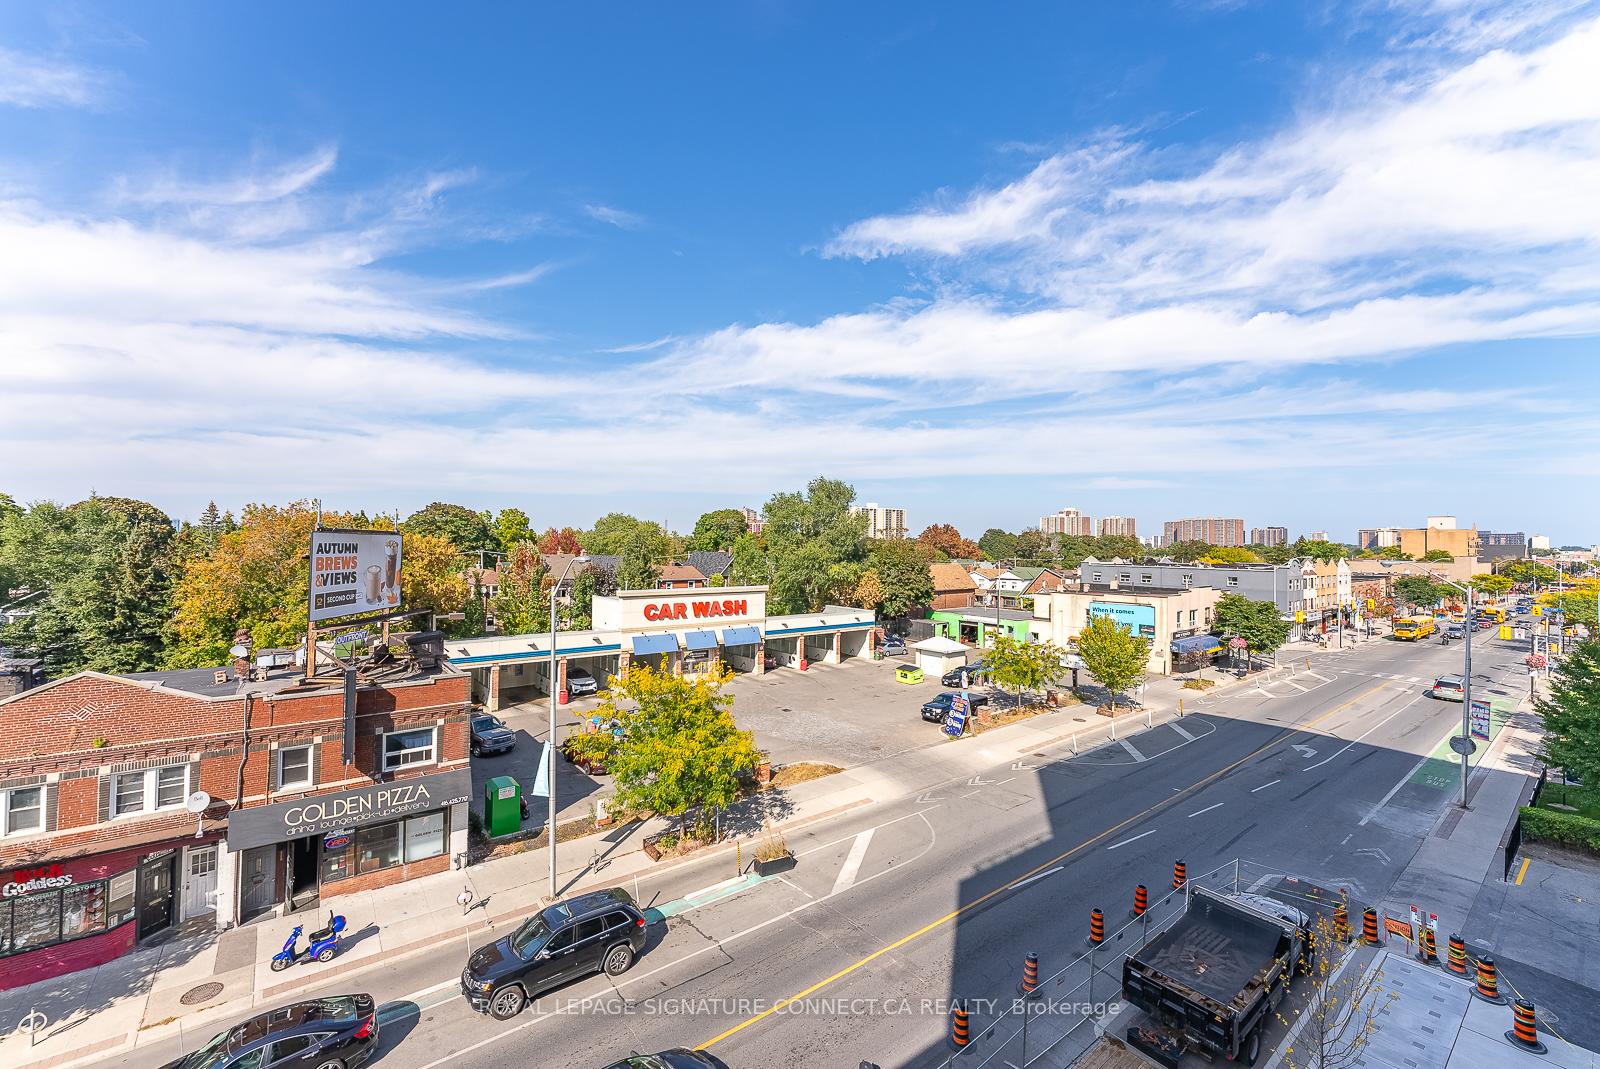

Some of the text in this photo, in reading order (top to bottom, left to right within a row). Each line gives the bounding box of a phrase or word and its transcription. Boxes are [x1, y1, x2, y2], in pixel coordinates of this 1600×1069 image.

[316, 543, 358, 554] AUTUMN
[315, 556, 358, 571] BREWS
[327, 595, 345, 603] SECOND
[643, 599, 747, 621] CAR WASH
[284, 783, 431, 826] GOLDEN PIZZA
[286, 824, 315, 836] dining
[2, 874, 73, 897] Goddess
